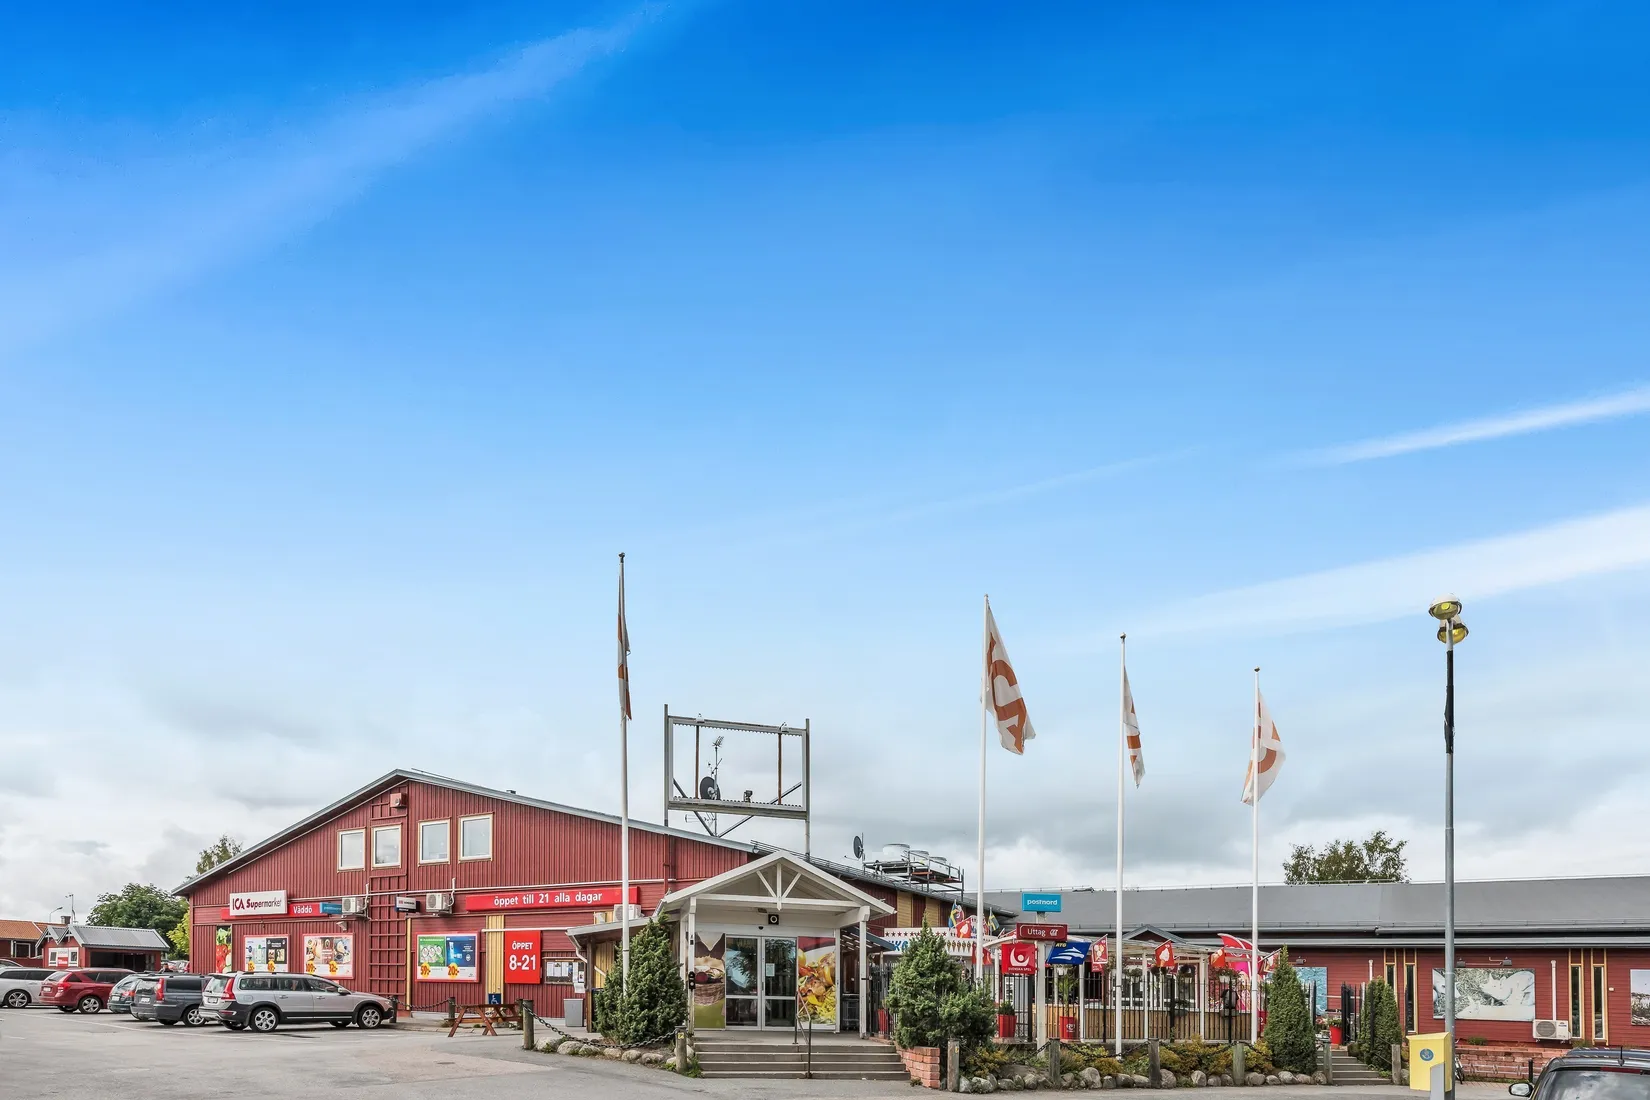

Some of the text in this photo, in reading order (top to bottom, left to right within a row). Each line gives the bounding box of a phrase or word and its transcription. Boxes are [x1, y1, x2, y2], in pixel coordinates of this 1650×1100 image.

[232, 896, 282, 911] ICA Supermarket
[494, 891, 603, 907] öppet till 21 alla dagar
[1026, 898, 1058, 906] postnord
[293, 905, 313, 914] Väddö
[1027, 928, 1046, 937] Uttag
[512, 940, 533, 950] ÖPPET
[509, 954, 536, 971] 8-21
